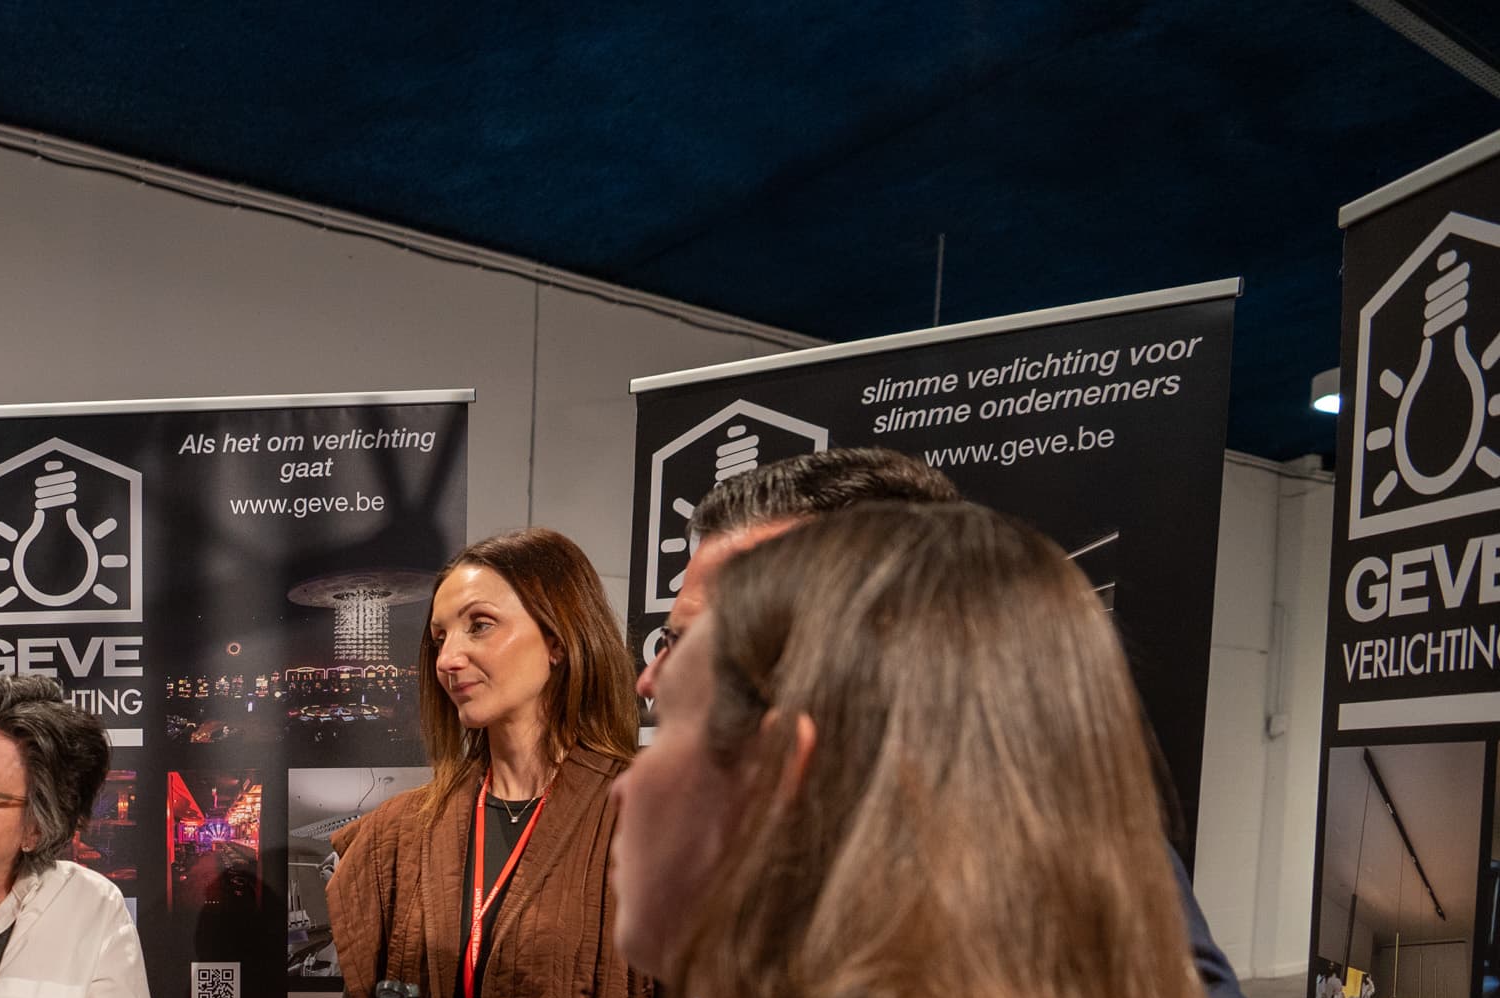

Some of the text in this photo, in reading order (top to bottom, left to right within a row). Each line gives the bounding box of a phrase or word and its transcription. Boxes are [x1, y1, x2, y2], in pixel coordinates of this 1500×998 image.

[861, 336, 1203, 405] slimme verlichting voor
[873, 373, 1182, 434] slimme ondernemers
[178, 427, 437, 455] Als het om verlichting
[924, 425, 1116, 468] www.geve.be
[279, 457, 334, 483] gaat
[230, 491, 385, 518] www.geve.be
[1342, 624, 1500, 684] VERLICHTIN
